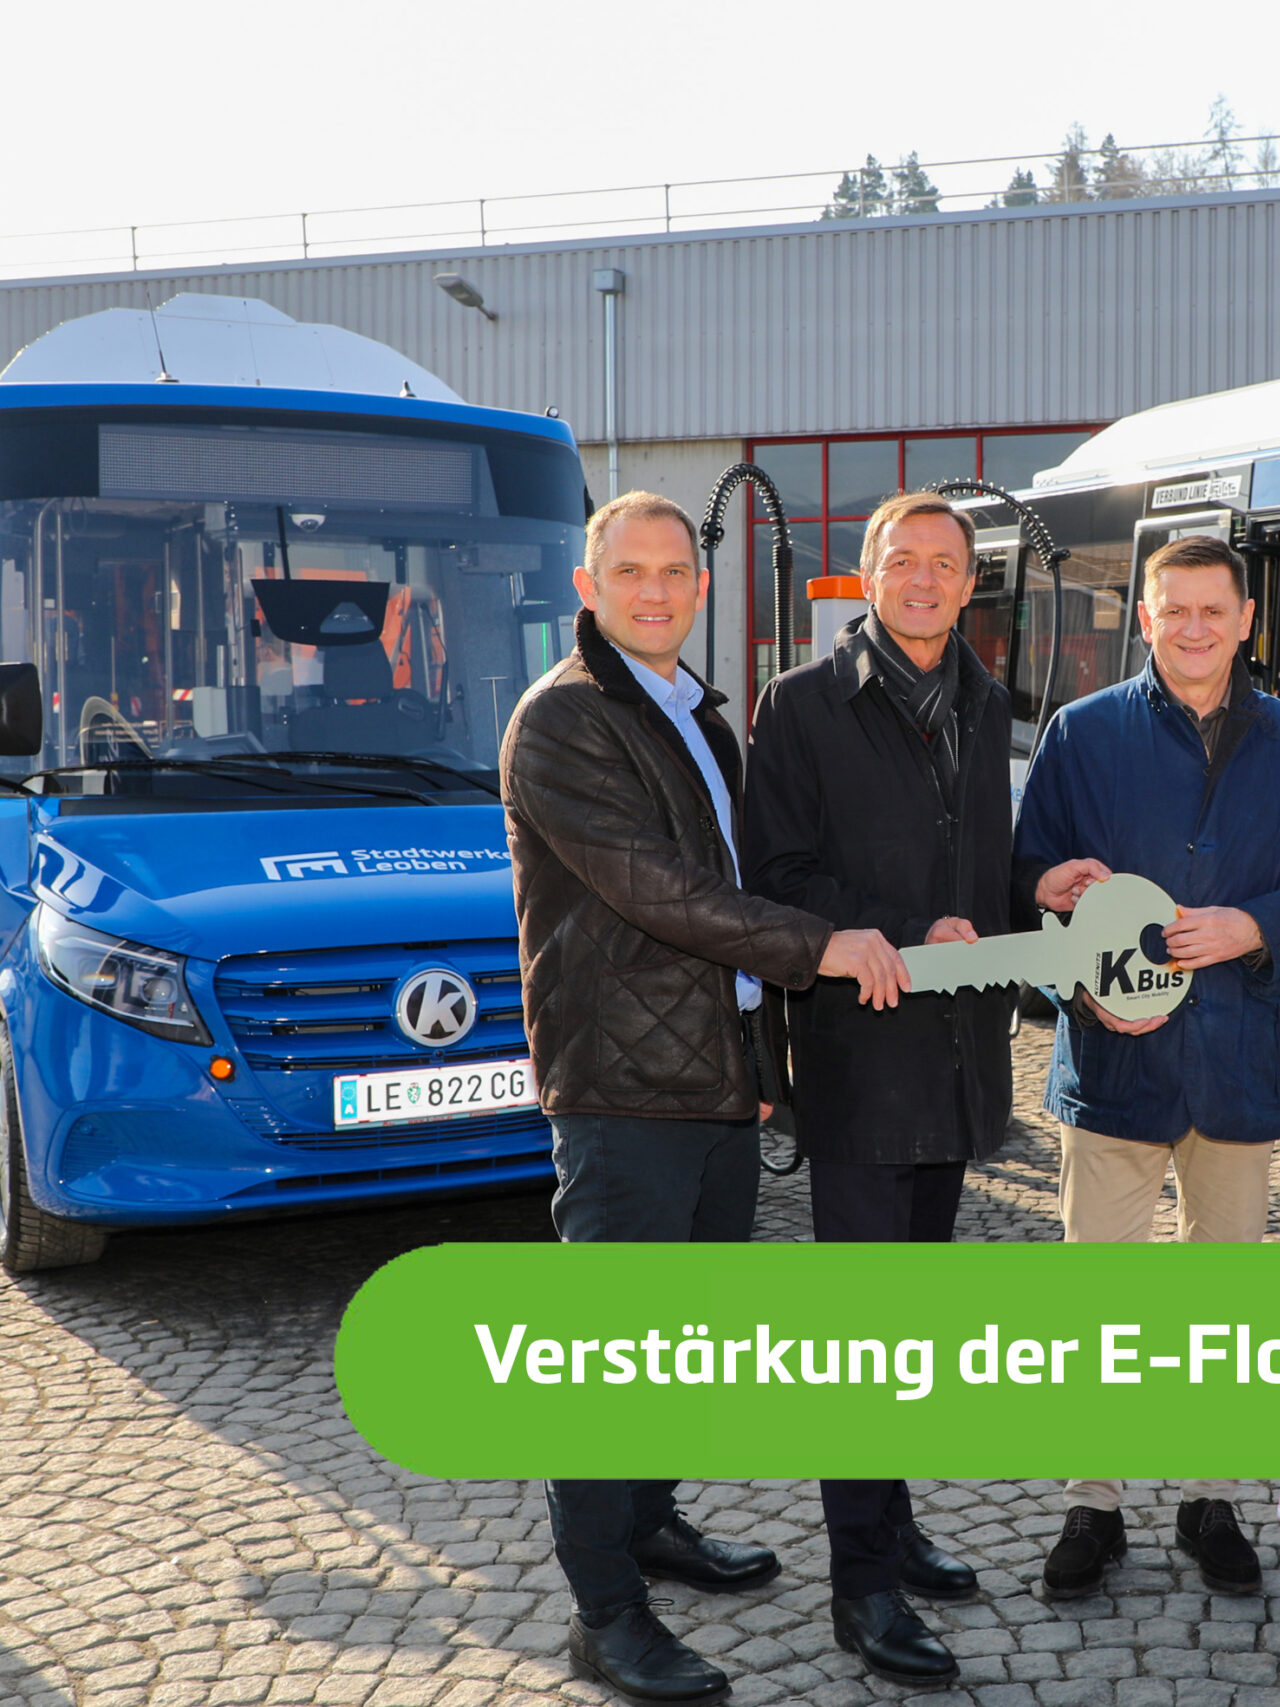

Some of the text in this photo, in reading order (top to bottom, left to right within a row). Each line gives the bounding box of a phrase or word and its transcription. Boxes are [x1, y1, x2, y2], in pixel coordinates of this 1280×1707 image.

[1155, 486, 1189, 505] VERBUND
[1189, 483, 1208, 500] LINIE
[356, 858, 468, 873] Leoben
[366, 1082, 402, 1113] LE
